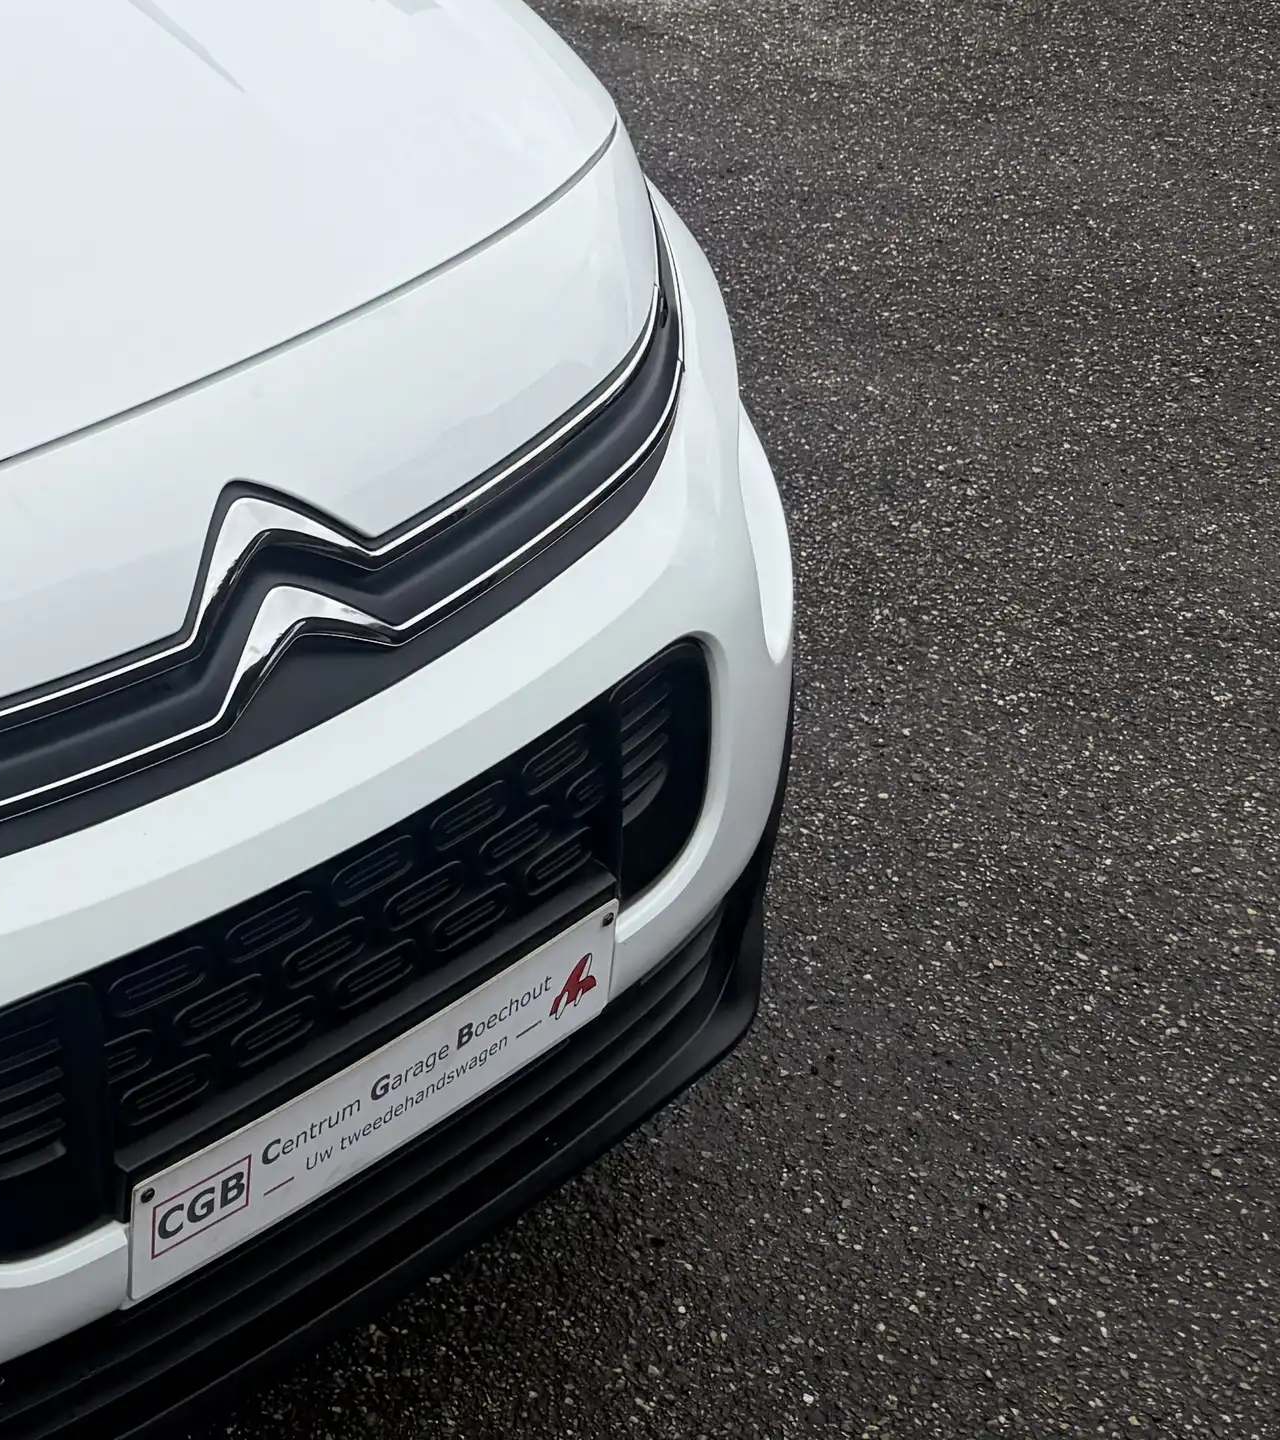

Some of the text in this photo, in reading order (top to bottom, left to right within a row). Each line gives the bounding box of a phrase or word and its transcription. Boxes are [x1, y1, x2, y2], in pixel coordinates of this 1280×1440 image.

[261, 975, 553, 1166] Centrum Garage Boechout
[305, 1034, 509, 1171] Uw tweedehandswagen
[157, 1170, 246, 1241] CGB
